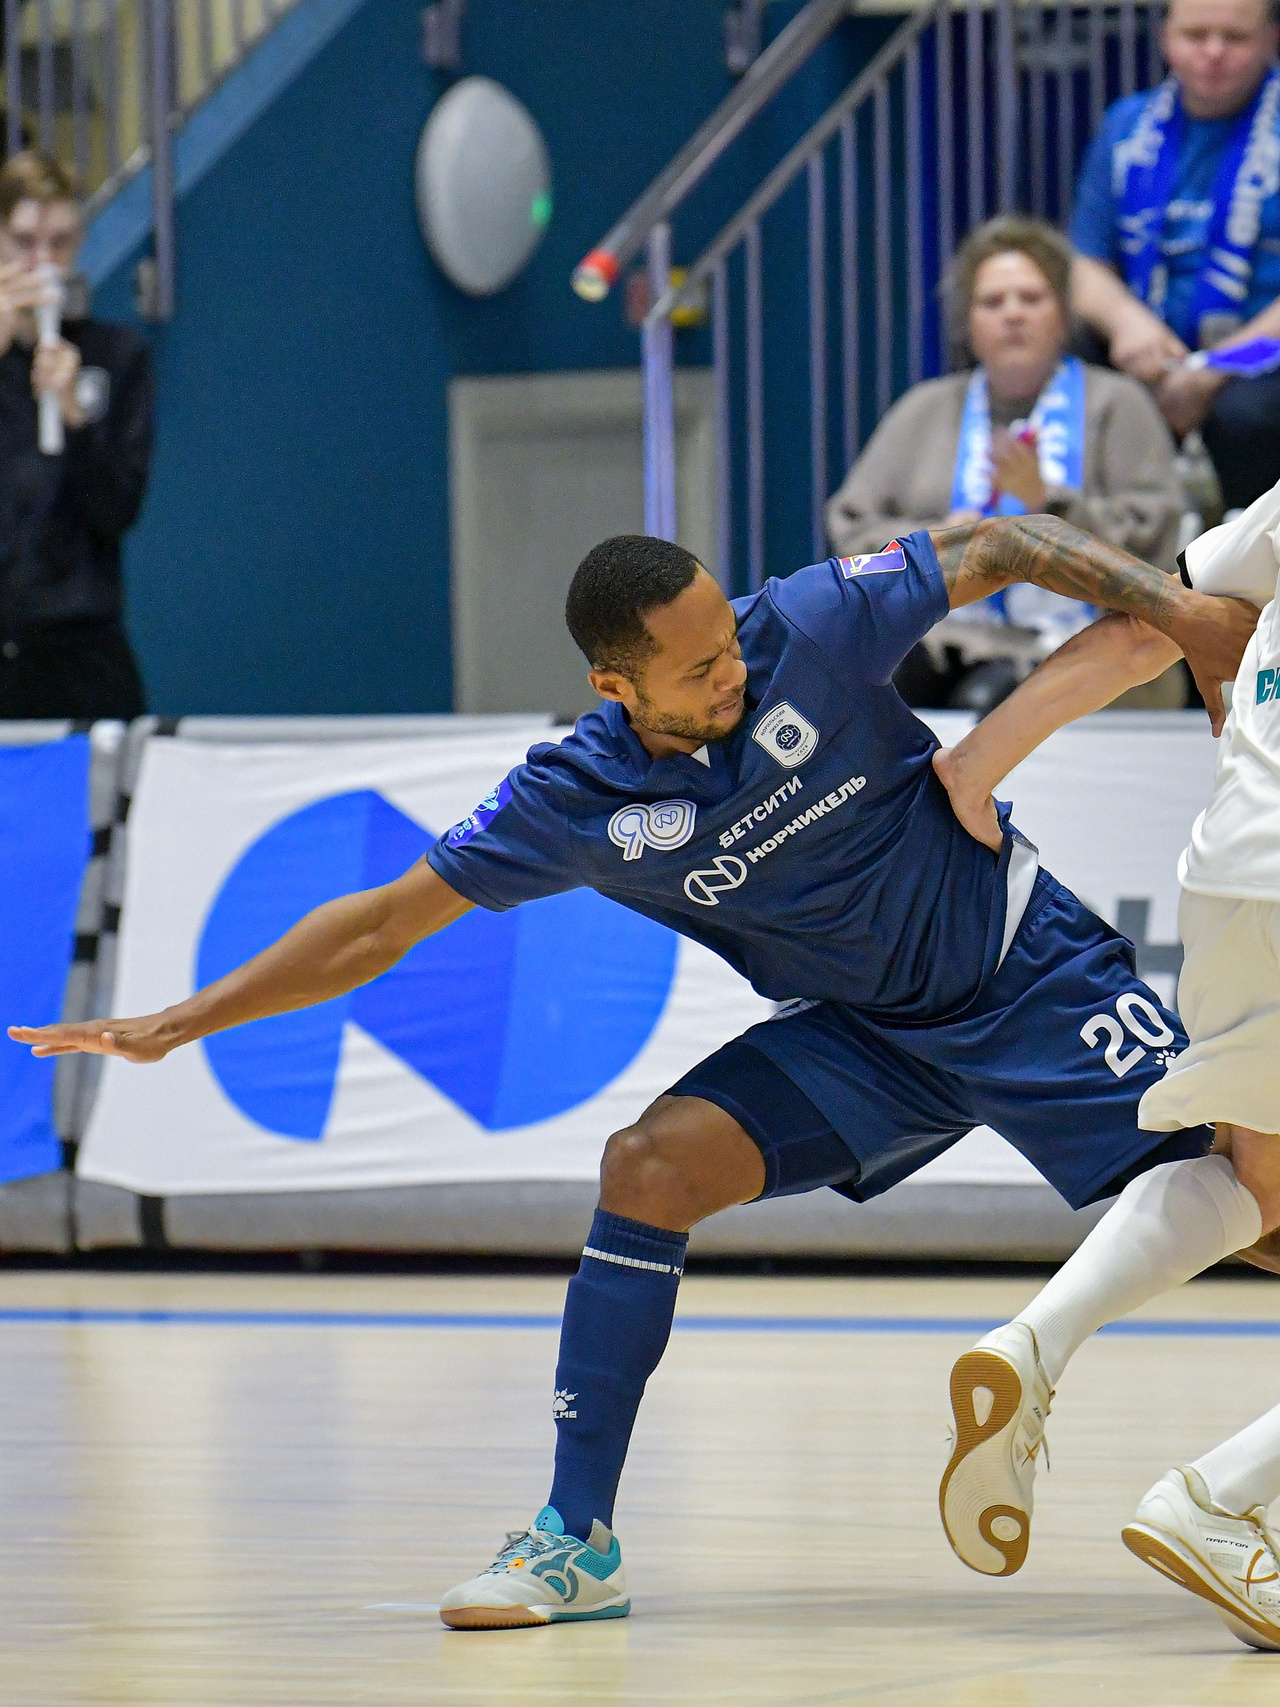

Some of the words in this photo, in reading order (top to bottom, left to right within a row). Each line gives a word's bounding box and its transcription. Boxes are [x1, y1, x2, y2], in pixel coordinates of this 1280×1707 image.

[718, 775, 804, 850] БЕТСИТИ
[745, 774, 868, 864] НОРНИКЕЛЬ
[1080, 992, 1175, 1078] 20
[553, 1410, 578, 1419] LME
[1205, 1537, 1249, 1549] RAPTOR
